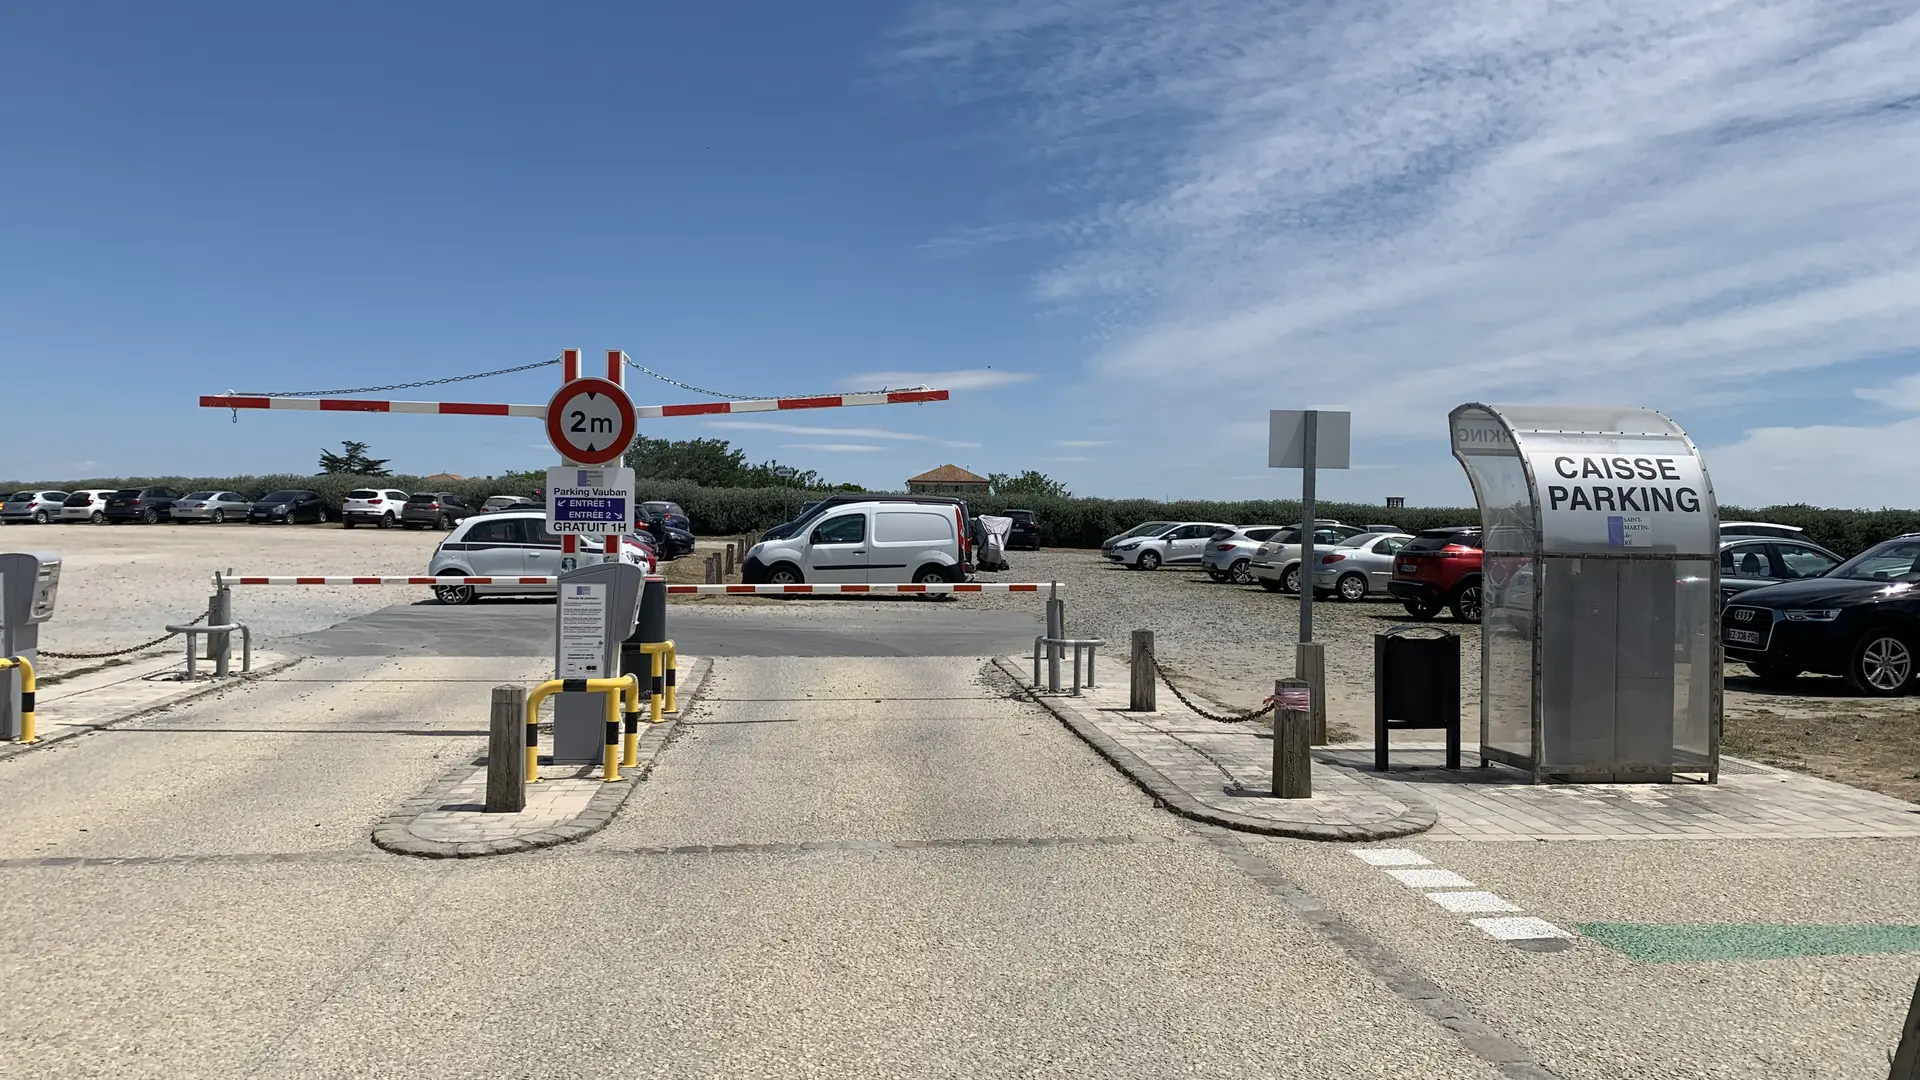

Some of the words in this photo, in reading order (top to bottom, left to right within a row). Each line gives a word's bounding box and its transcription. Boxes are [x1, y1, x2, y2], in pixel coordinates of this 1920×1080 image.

[1554, 456, 1681, 480] CAISSE
[554, 488, 590, 497] Parking
[592, 488, 626, 496] Vauban
[570, 498, 604, 507] ENTRÉE
[1548, 485, 1701, 512] PARKING
[569, 510, 604, 518] ENTRÉE
[553, 522, 608, 532] GRATUIT
[611, 522, 627, 532] 1H
